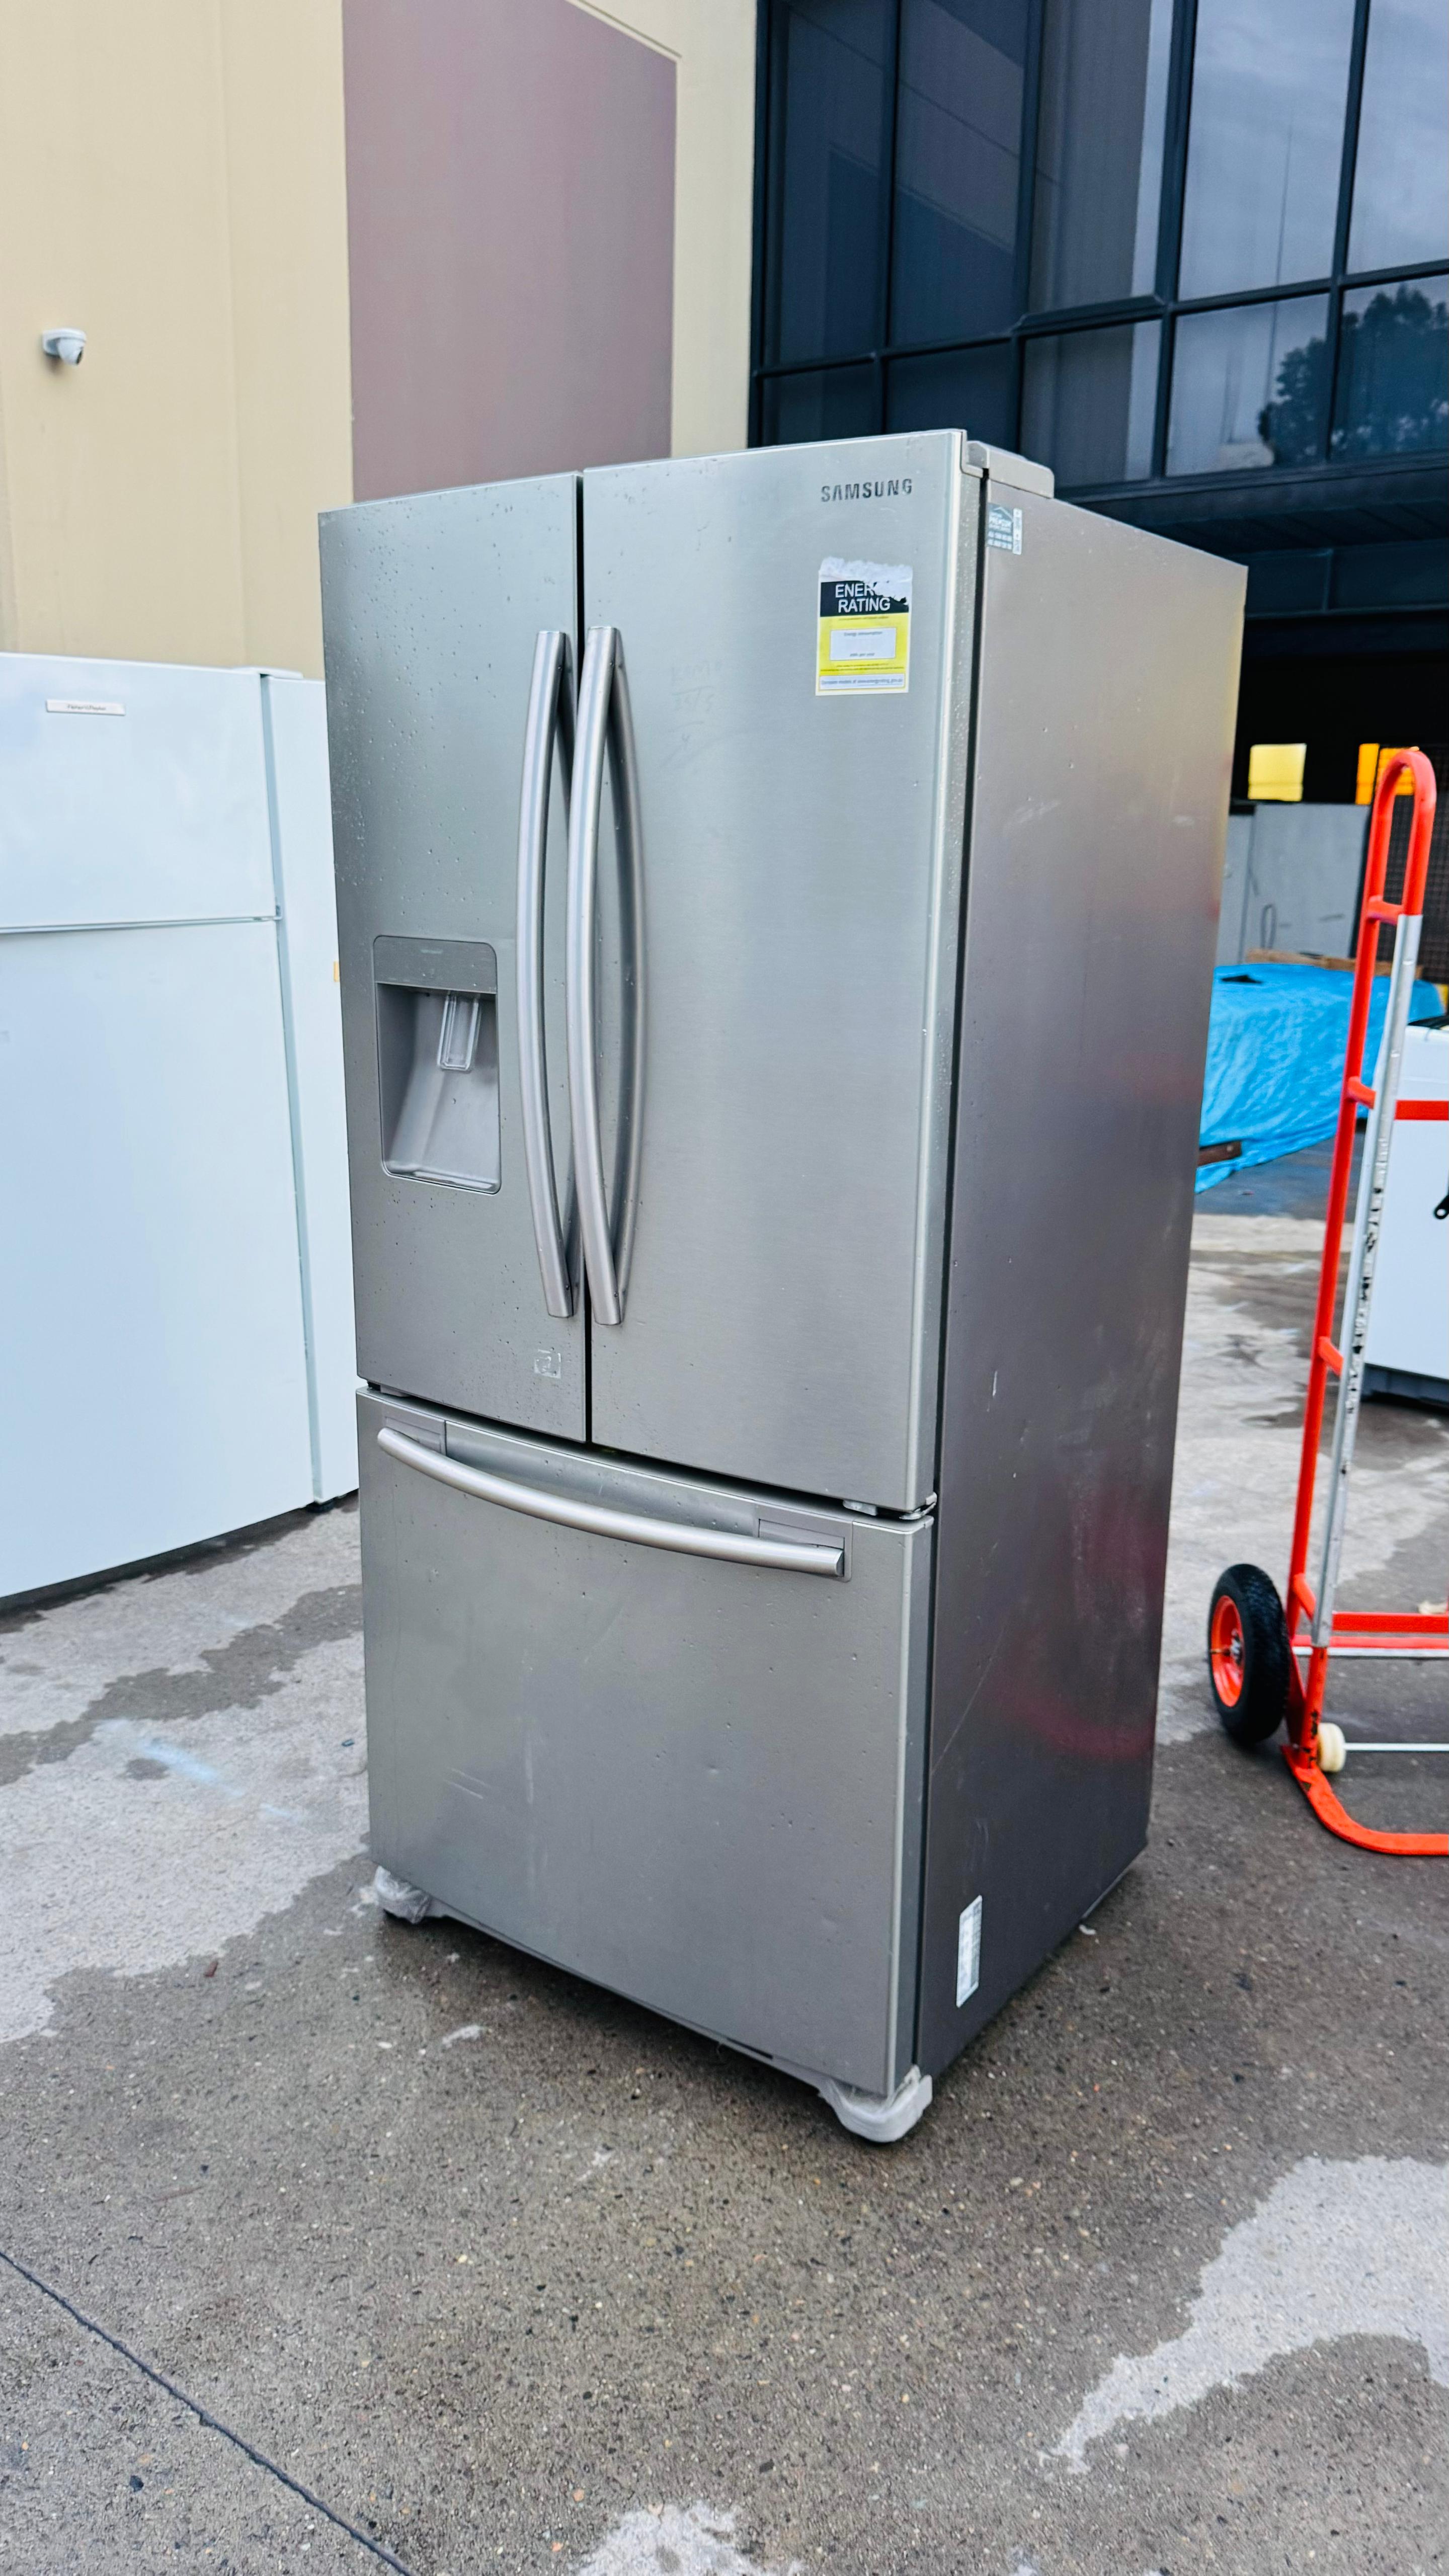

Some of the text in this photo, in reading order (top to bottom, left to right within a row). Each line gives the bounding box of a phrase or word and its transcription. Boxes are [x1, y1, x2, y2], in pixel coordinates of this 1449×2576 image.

[821, 478, 912, 502] SAMSUNG
[835, 583, 876, 598] ENER
[838, 597, 891, 613] RATING
